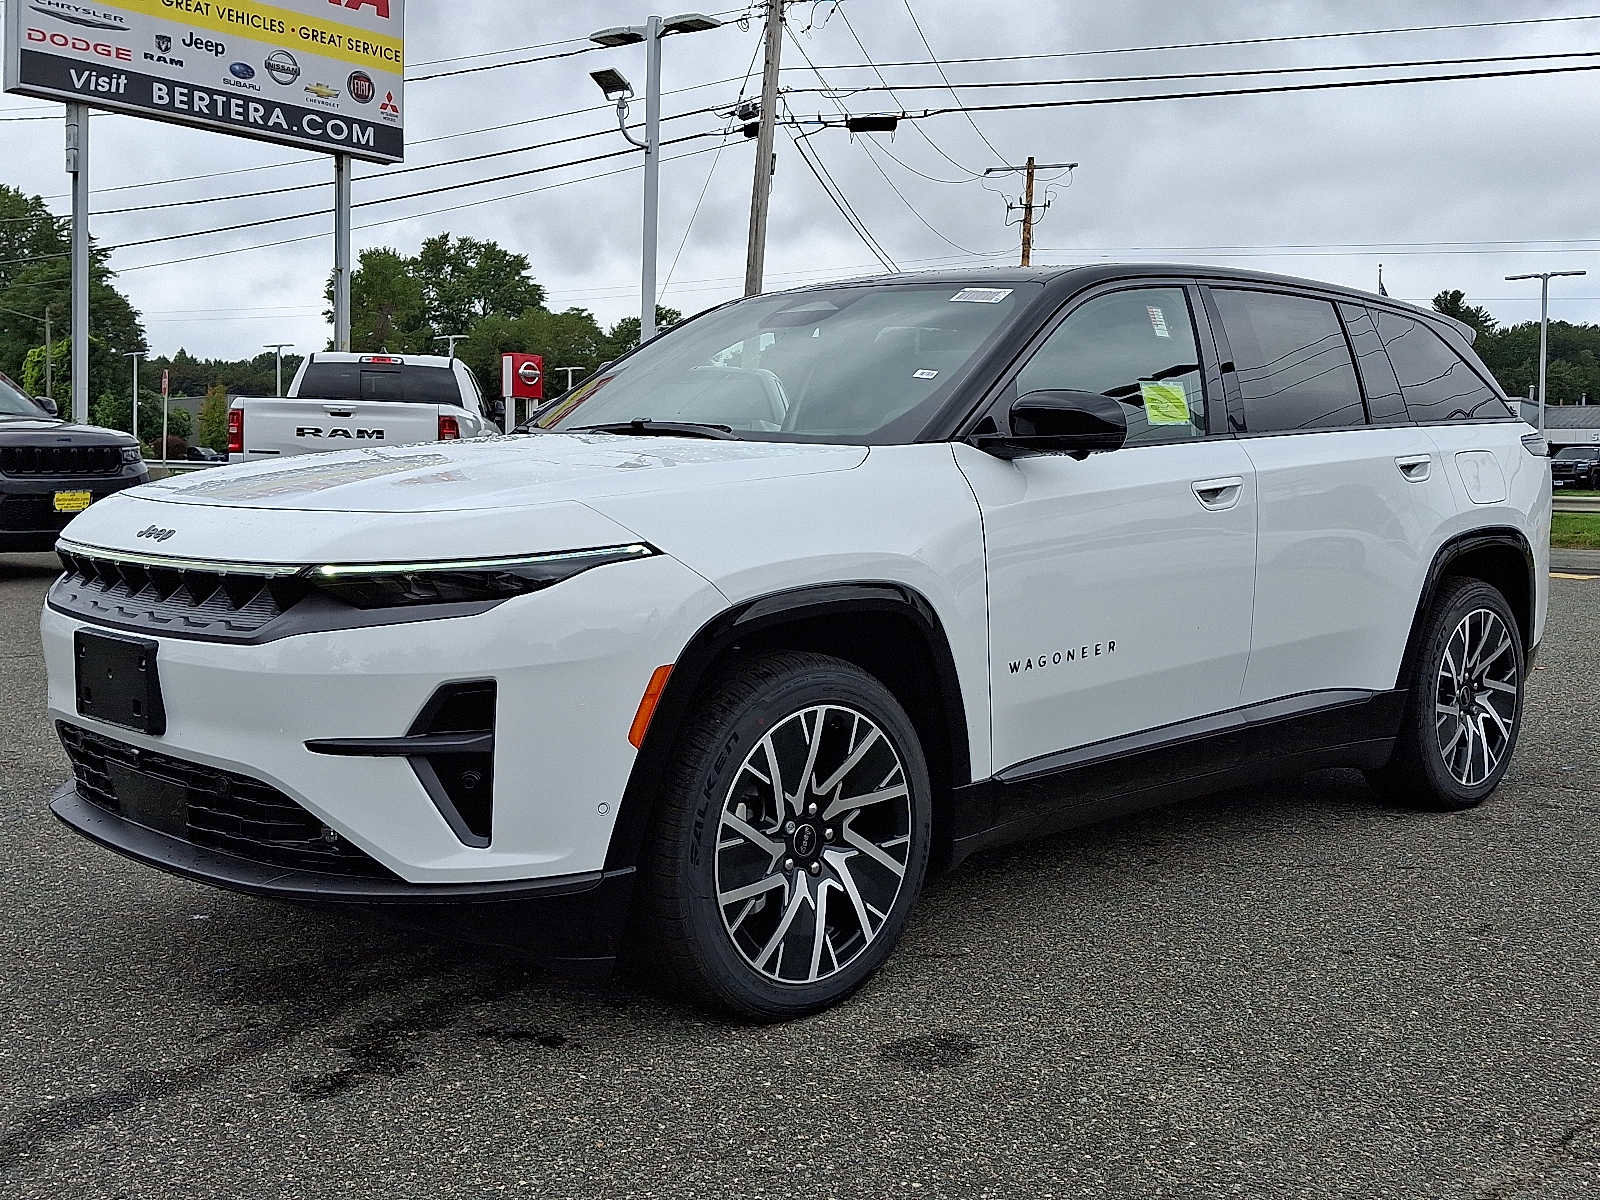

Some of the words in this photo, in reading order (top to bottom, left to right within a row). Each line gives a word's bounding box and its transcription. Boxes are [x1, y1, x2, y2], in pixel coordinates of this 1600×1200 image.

[35, 0, 125, 23] CHRYSLER
[162, 0, 210, 16] GREAT
[216, 5, 285, 34] VEHICLES
[299, 26, 343, 48] GREAT
[347, 38, 401, 63] SERVICE
[27, 28, 132, 62] DODGE
[181, 32, 226, 57] Jeep
[143, 52, 184, 68] RAM
[267, 61, 299, 76] NISSAN
[222, 77, 261, 92] SUBARU
[354, 79, 371, 96] FIAT
[69, 68, 128, 94] Visit
[152, 82, 375, 147] BERTERA.COM
[295, 426, 385, 440] RAM
[136, 524, 176, 543] Jeep
[1008, 640, 1116, 674] WAGONEER
